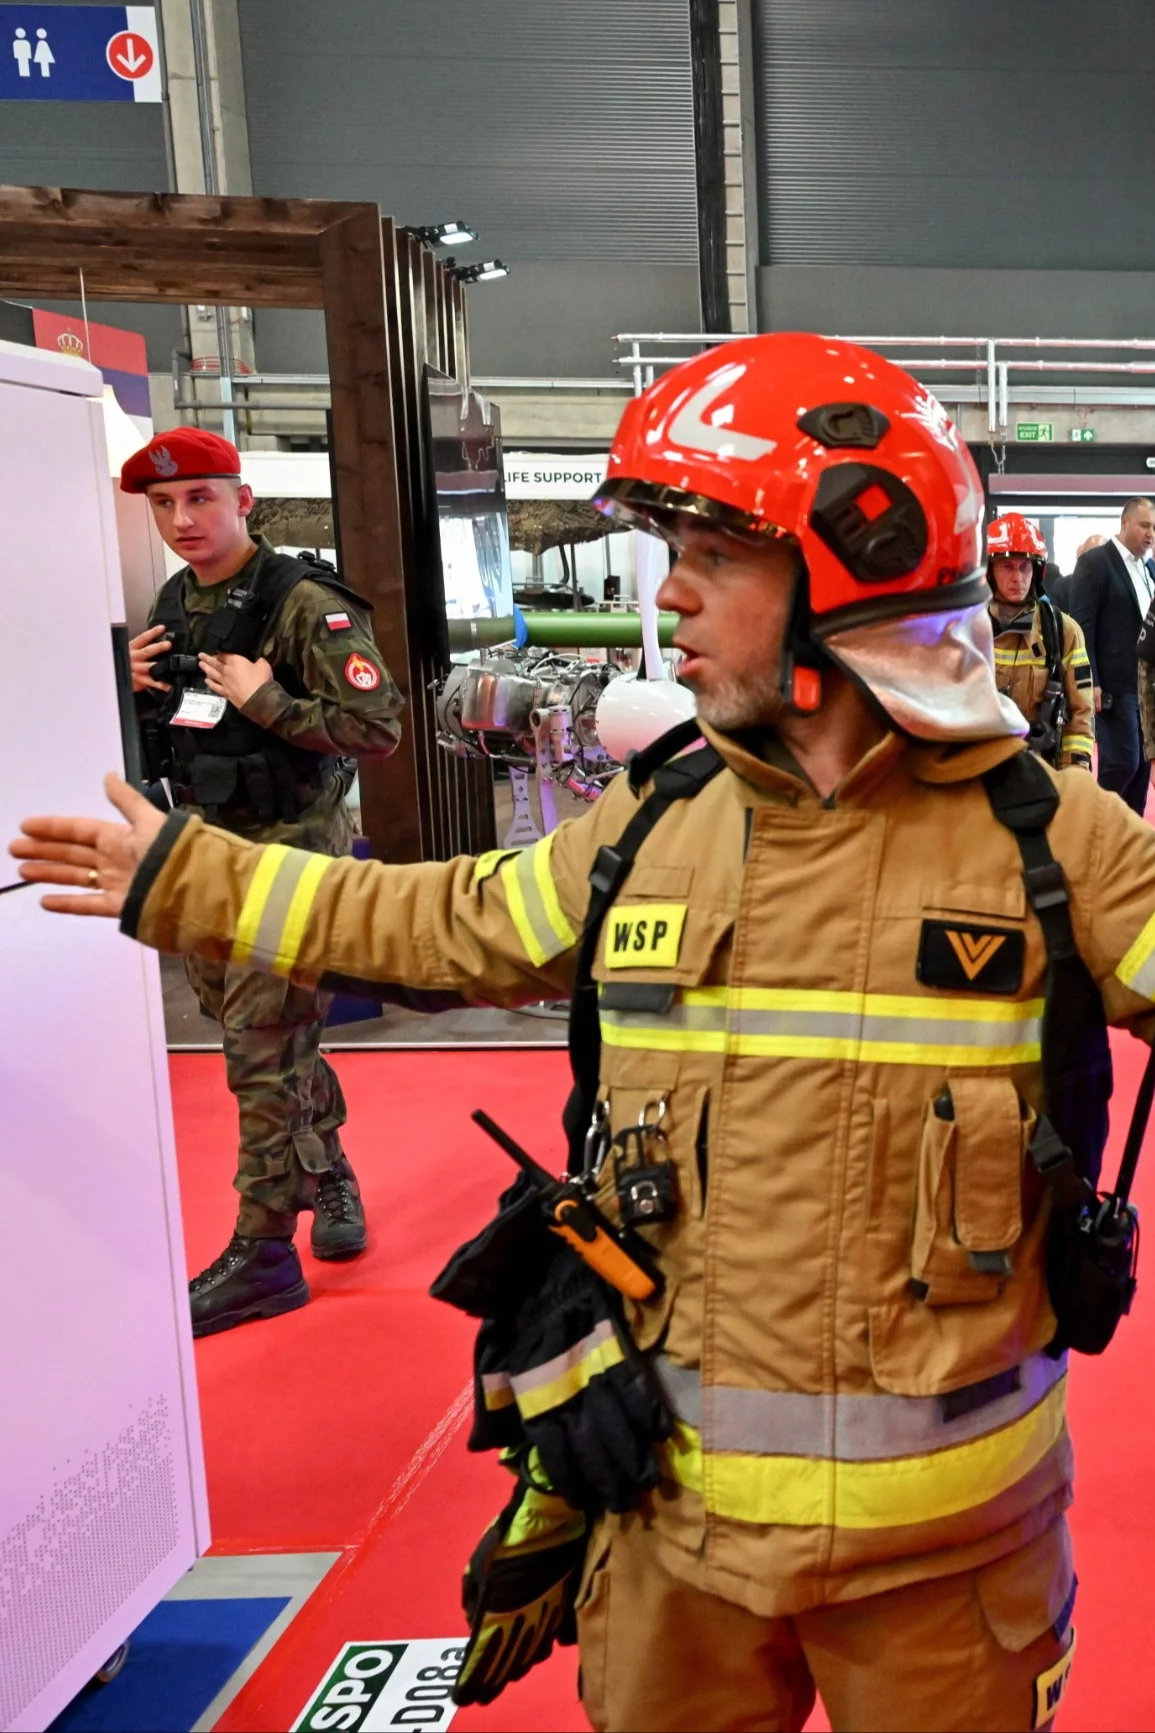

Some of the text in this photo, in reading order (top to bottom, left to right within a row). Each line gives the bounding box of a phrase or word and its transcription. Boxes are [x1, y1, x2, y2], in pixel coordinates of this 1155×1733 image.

[505, 472, 602, 483] IFE SUPPORT
[613, 920, 668, 953] WSP
